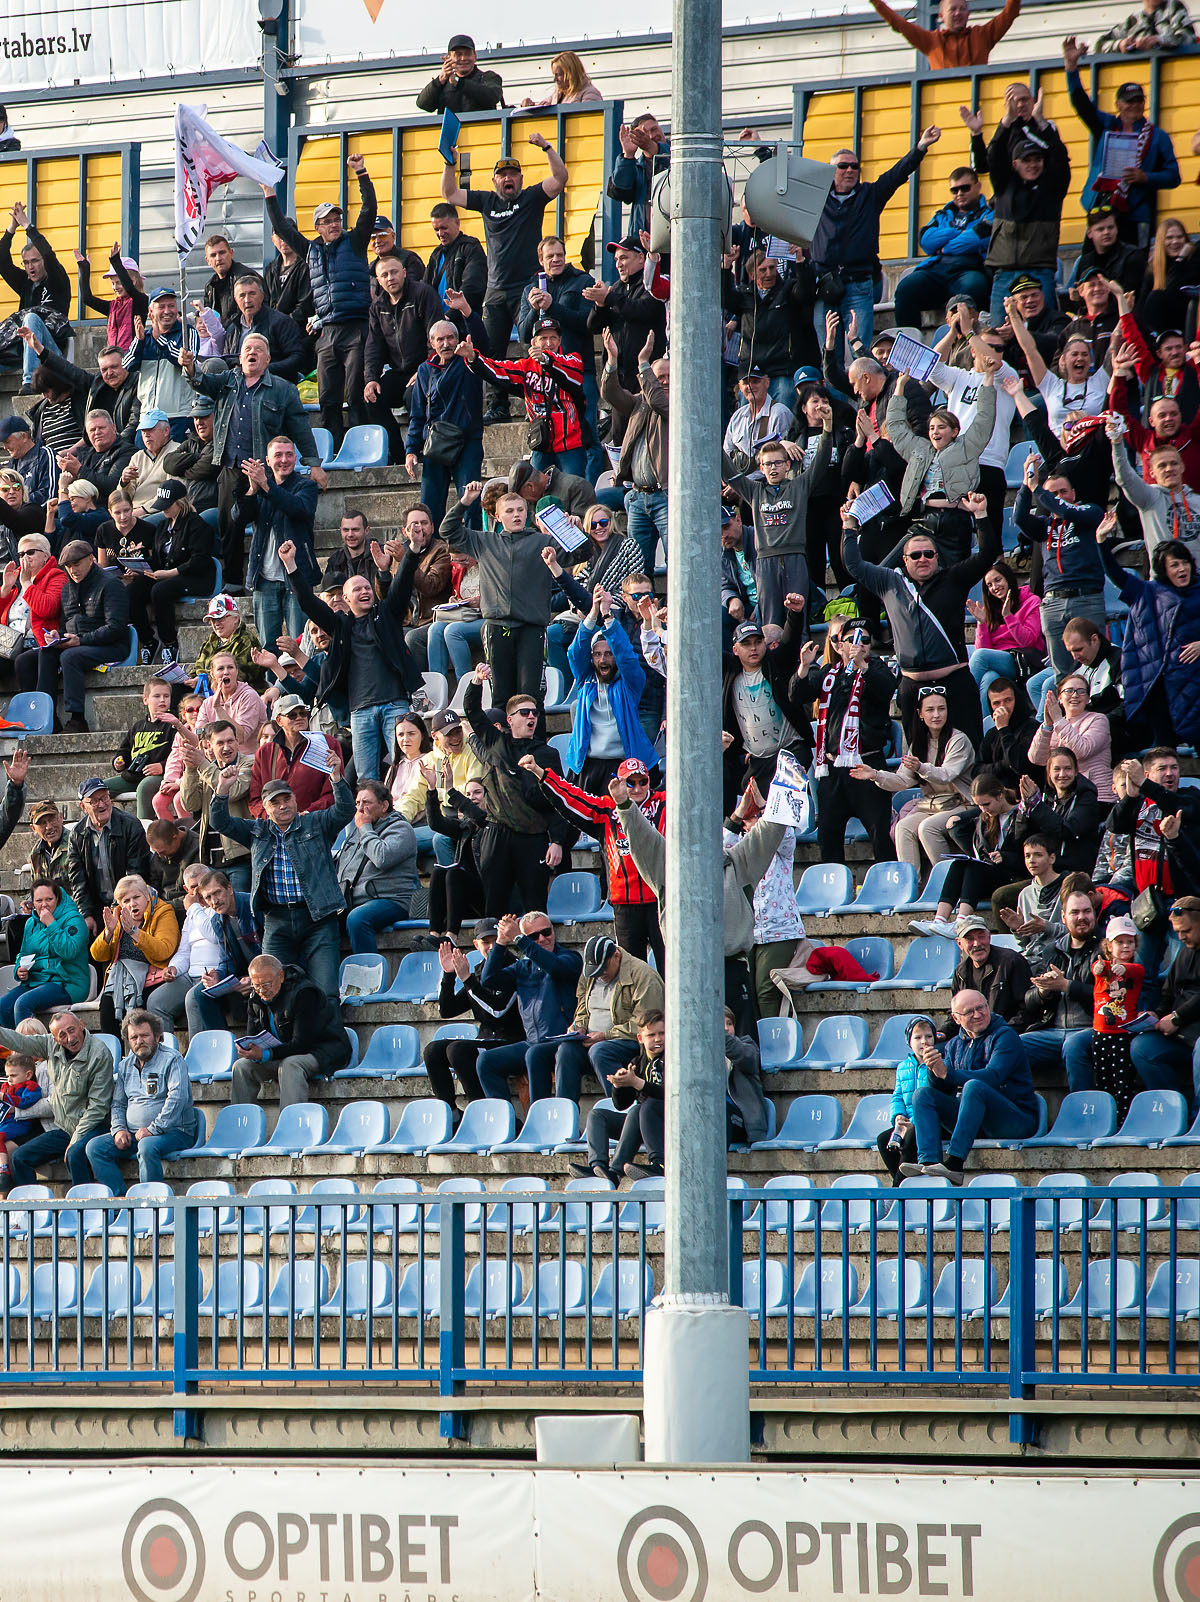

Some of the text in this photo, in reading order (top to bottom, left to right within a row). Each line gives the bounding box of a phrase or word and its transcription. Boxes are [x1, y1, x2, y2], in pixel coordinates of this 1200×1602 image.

[886, 870, 900, 884] 16
[810, 1109, 822, 1122] 19
[822, 1270, 835, 1283] 22
[224, 1510, 459, 1585] OPTIBET
[728, 1519, 982, 1597] OPTIBET
